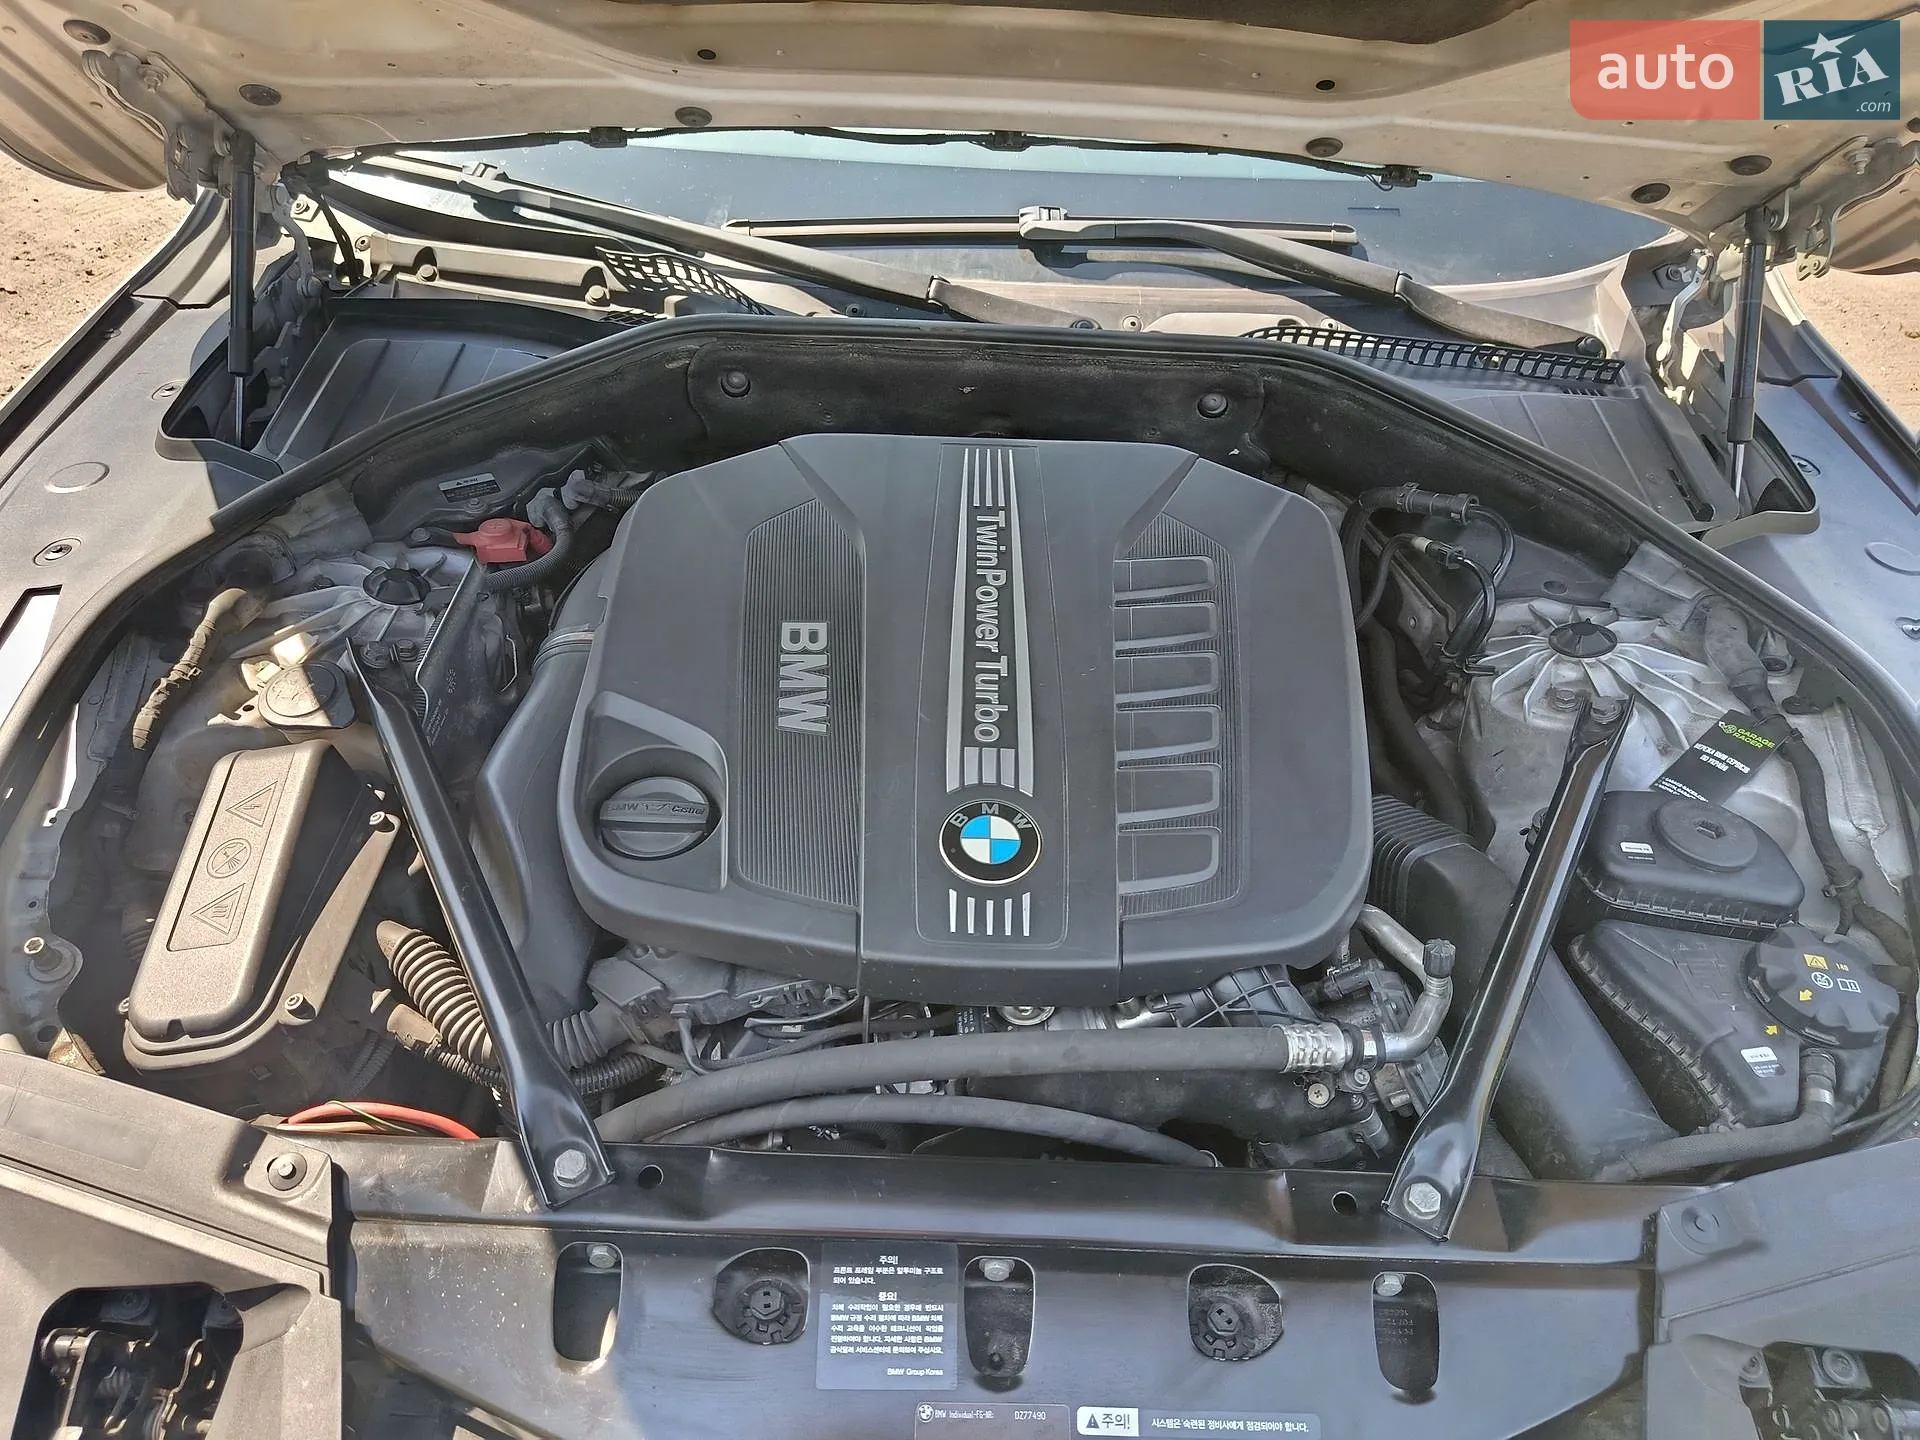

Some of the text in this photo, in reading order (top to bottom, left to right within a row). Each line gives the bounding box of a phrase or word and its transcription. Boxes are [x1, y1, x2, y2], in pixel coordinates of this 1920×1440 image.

[973, 510, 1008, 743] TwinPower Turbo
[777, 621, 831, 736] BMW
[1732, 732, 1764, 749] RACER
[1738, 728, 1776, 749] GARAGE
[949, 802, 1032, 831] BMW
[906, 1368, 925, 1377] Group
[1102, 1413, 1131, 1430] 주의!
[1151, 1417, 1181, 1429] 시스템은
[1207, 1419, 1244, 1431] 정비사에게
[1246, 1420, 1283, 1432] 점검되어야
[1284, 1421, 1309, 1433] 합니다.
